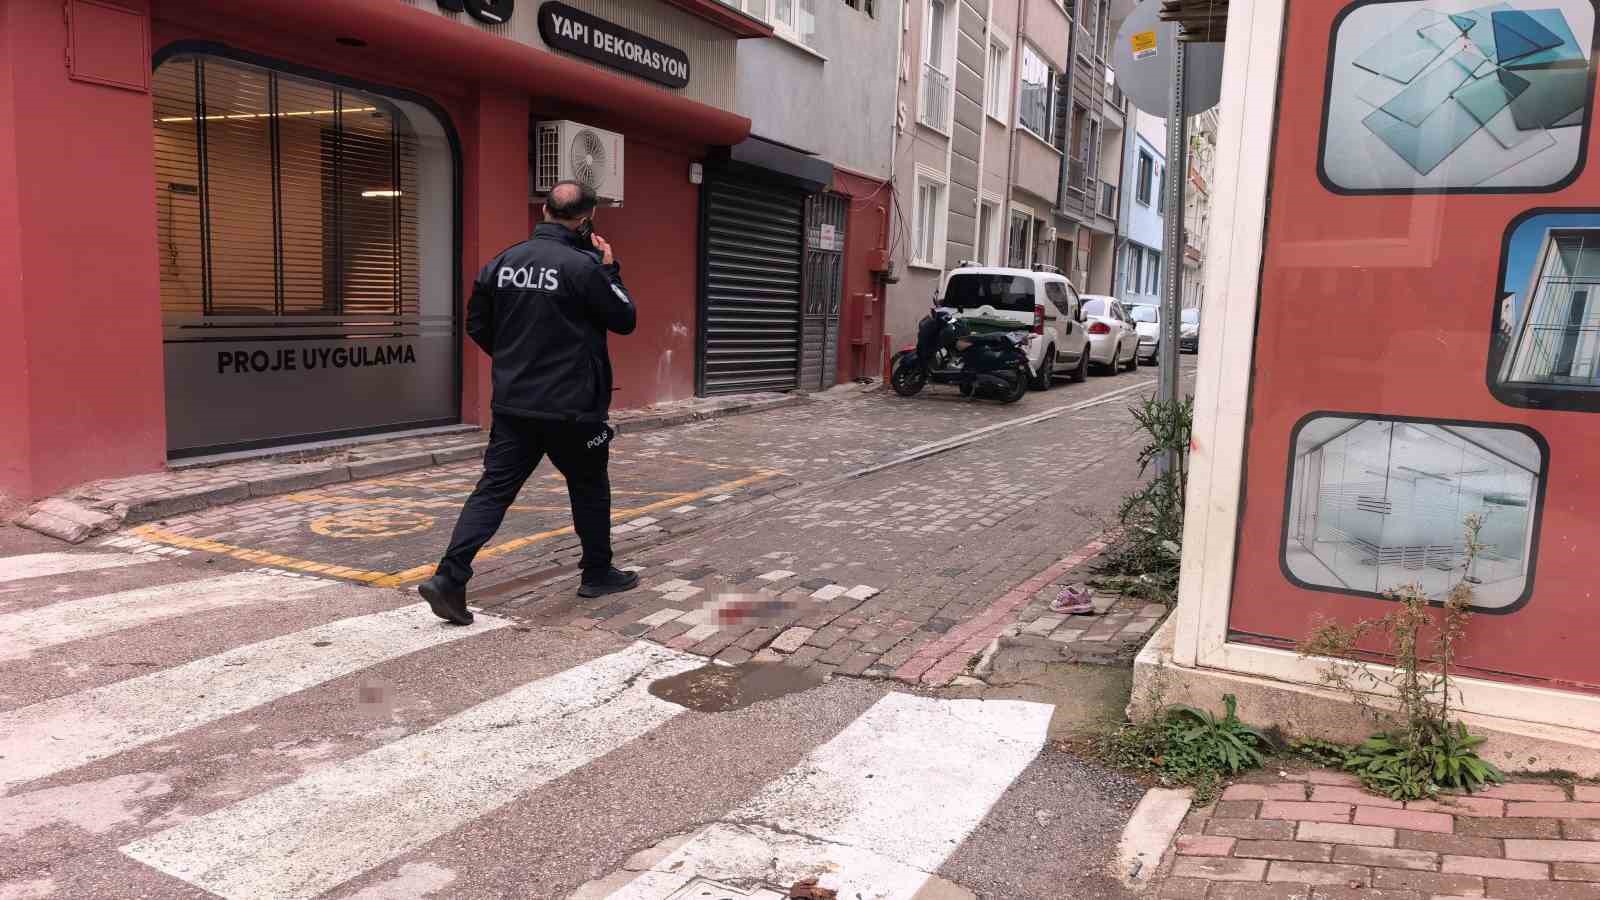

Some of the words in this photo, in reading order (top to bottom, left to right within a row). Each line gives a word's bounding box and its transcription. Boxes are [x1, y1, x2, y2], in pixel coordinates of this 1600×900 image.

[551, 13, 589, 44] YAPI
[593, 30, 688, 80] DEKORASYON
[217, 349, 297, 374] PROJE
[302, 344, 416, 370] UYGULAMA
